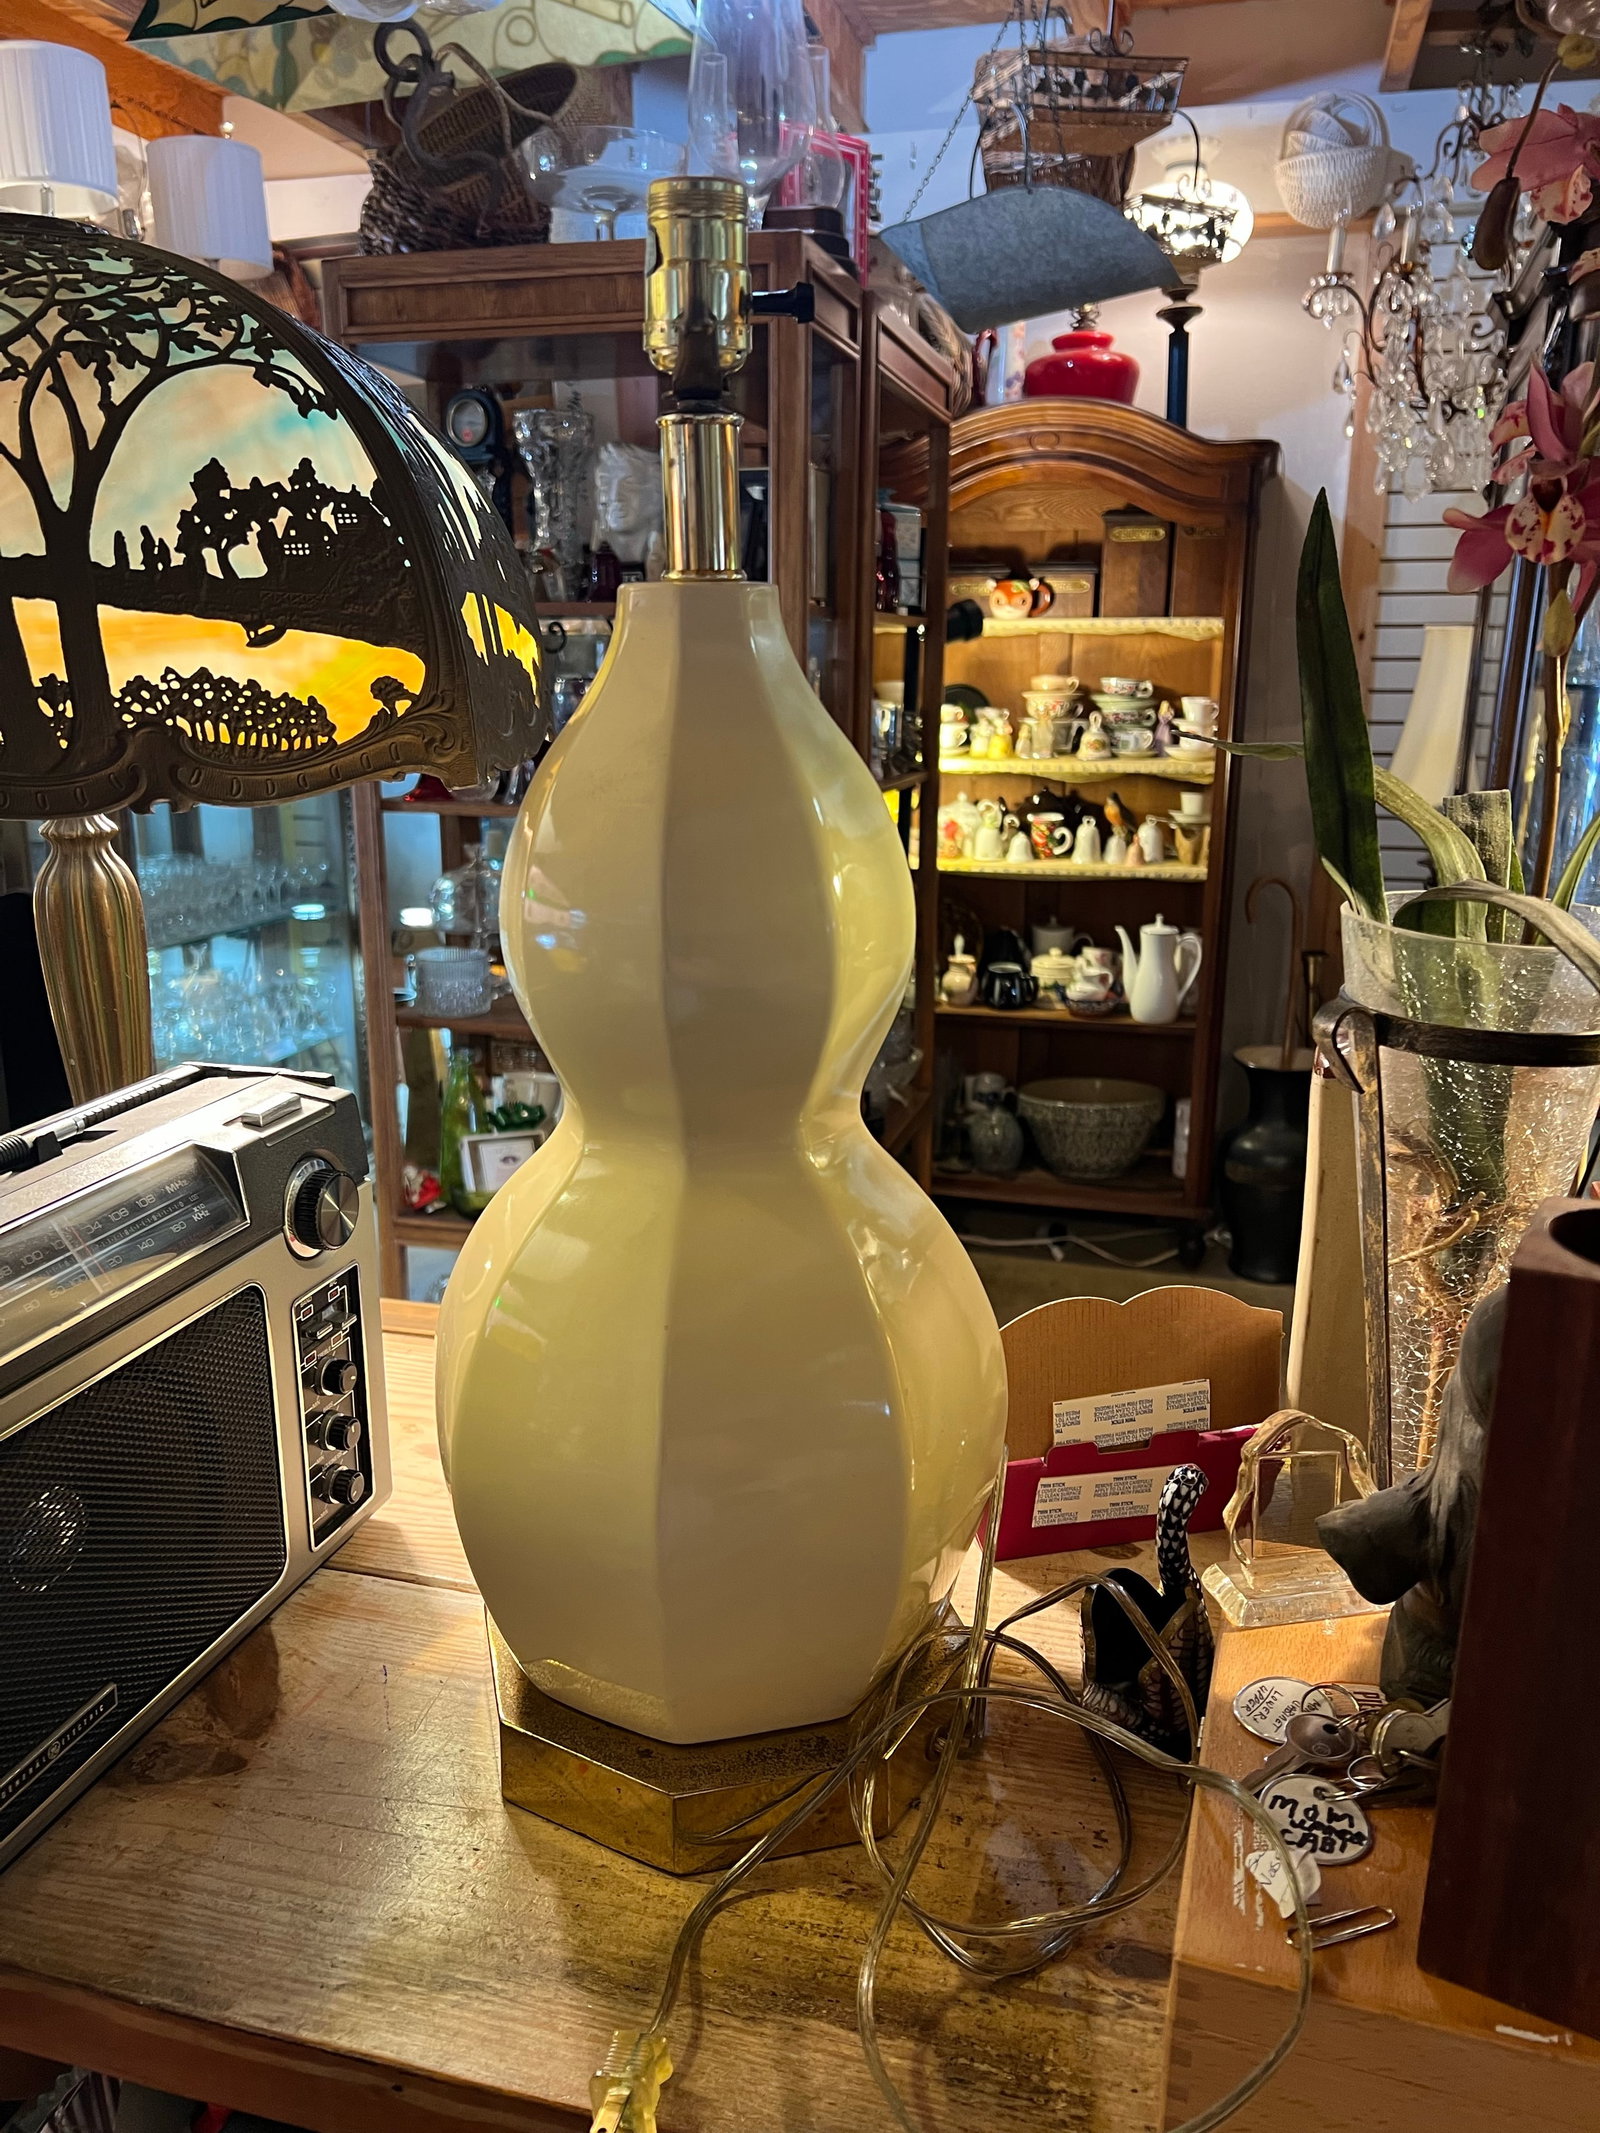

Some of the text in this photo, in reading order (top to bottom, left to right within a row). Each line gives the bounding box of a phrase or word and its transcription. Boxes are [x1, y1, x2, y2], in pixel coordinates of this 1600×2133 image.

[137, 1238, 155, 1252] 140
[1240, 1685, 1268, 1712] UPPER
[1269, 1794, 1355, 1829] MOM
